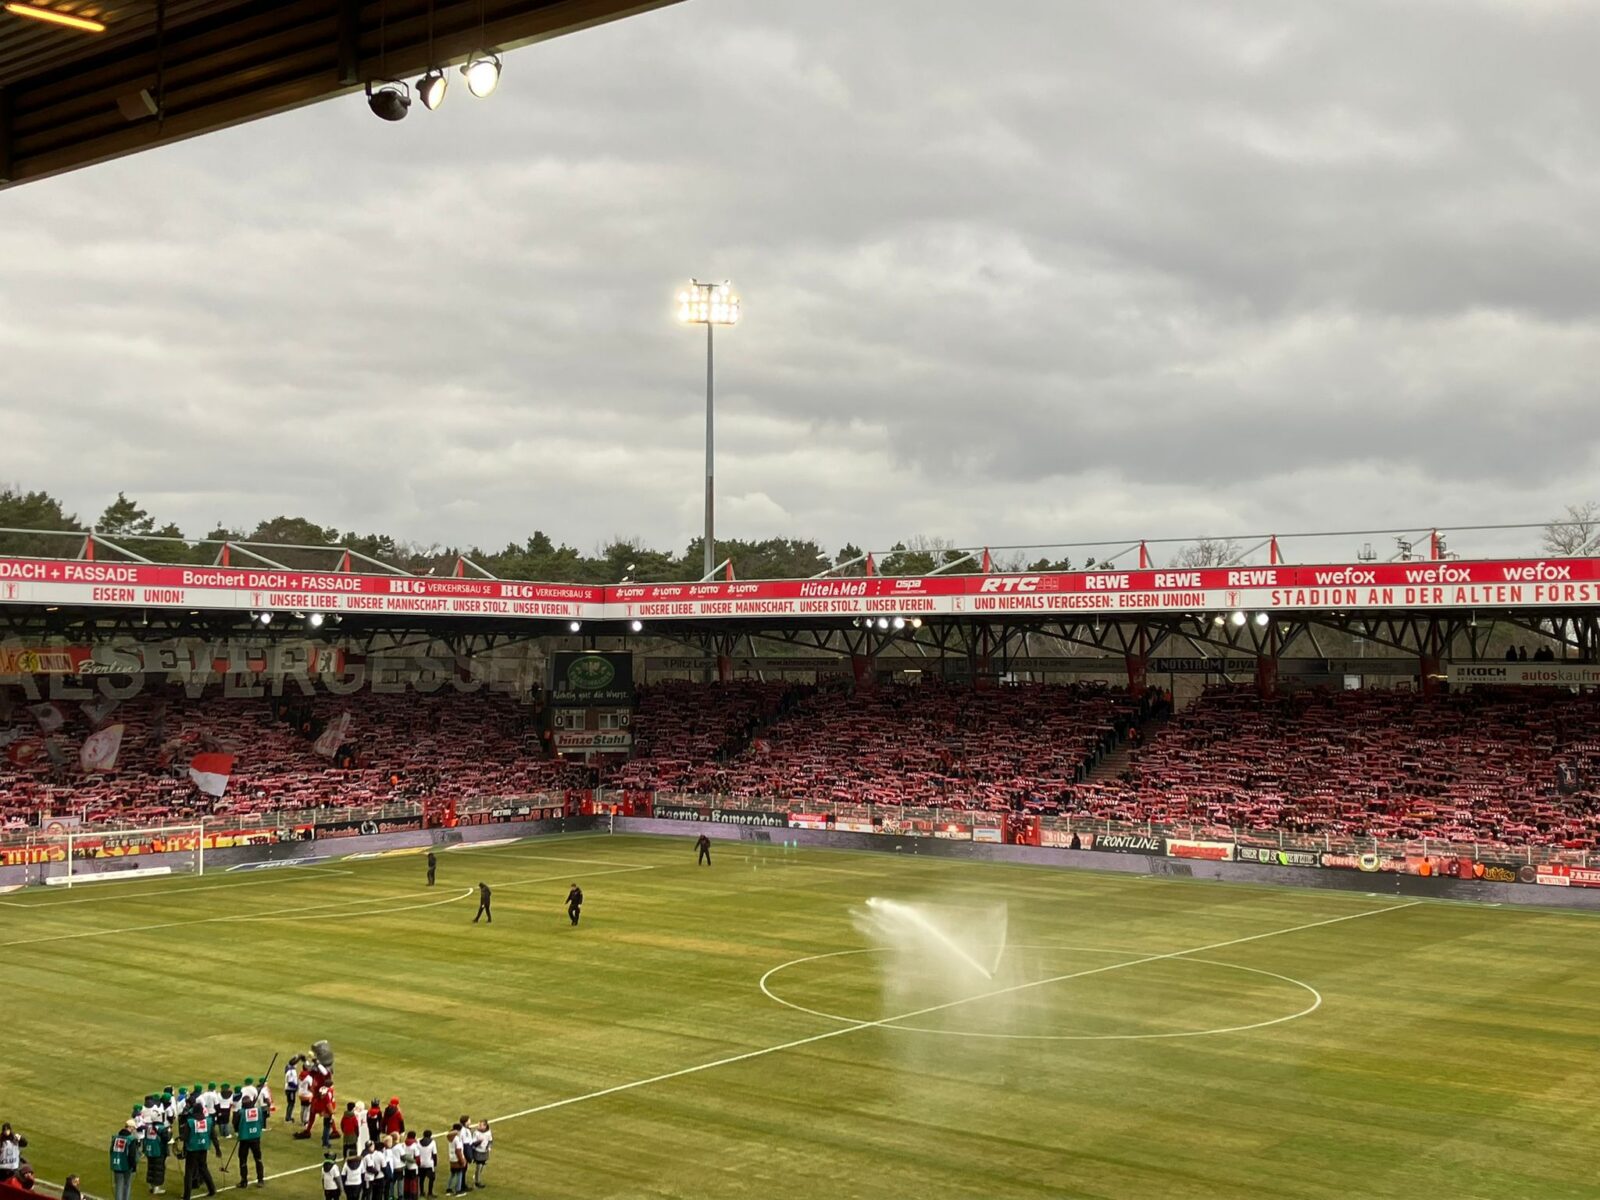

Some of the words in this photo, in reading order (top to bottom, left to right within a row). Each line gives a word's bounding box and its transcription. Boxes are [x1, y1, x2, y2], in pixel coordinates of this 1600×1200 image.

[1, 562, 46, 579] DACH
[65, 566, 138, 582] FASSADE
[1228, 570, 1278, 586] REWE
[1316, 568, 1376, 585] wefox
[1406, 565, 1471, 583] wefox
[1503, 562, 1570, 581] wefox
[183, 571, 244, 586] Borchert
[249, 574, 286, 588] DACH
[302, 576, 362, 591] FASSADE
[980, 577, 1040, 592] RTC
[1086, 575, 1130, 590] REWE
[1155, 573, 1201, 588] REWE
[92, 587, 135, 602] EISERN
[144, 589, 185, 604] UNION!
[270, 594, 308, 606] UNSERE
[311, 595, 340, 608] LIEBE.
[347, 596, 384, 609] UNSERE
[387, 599, 449, 611] MANNSCHAFT.
[453, 600, 480, 612] UNSER
[482, 601, 510, 612] STOLZ.
[514, 602, 540, 614] UNSER
[542, 603, 571, 614] VEREIN.
[974, 598, 996, 610] UND
[1000, 596, 1044, 609] NIEMALS
[1047, 595, 1114, 608] VERGESSEN:
[1119, 594, 1159, 608] EISERN
[1163, 592, 1205, 607] UNION!
[1272, 589, 1357, 606] STADION
[1368, 588, 1393, 604] AN
[1406, 587, 1444, 604] DER
[1456, 585, 1522, 603] ALTEN
[640, 604, 670, 615] UNSERE
[672, 604, 696, 614] LIEBE.
[700, 602, 732, 614] UNSERE
[736, 600, 795, 613] MANNSCHAFT.
[800, 600, 828, 612] UNSER
[831, 600, 861, 612] STOLZ.
[866, 600, 896, 611] UNSER
[900, 598, 936, 610] VEREIN.
[1466, 668, 1506, 676] KOCH
[1096, 835, 1160, 850] FRONTLINE
